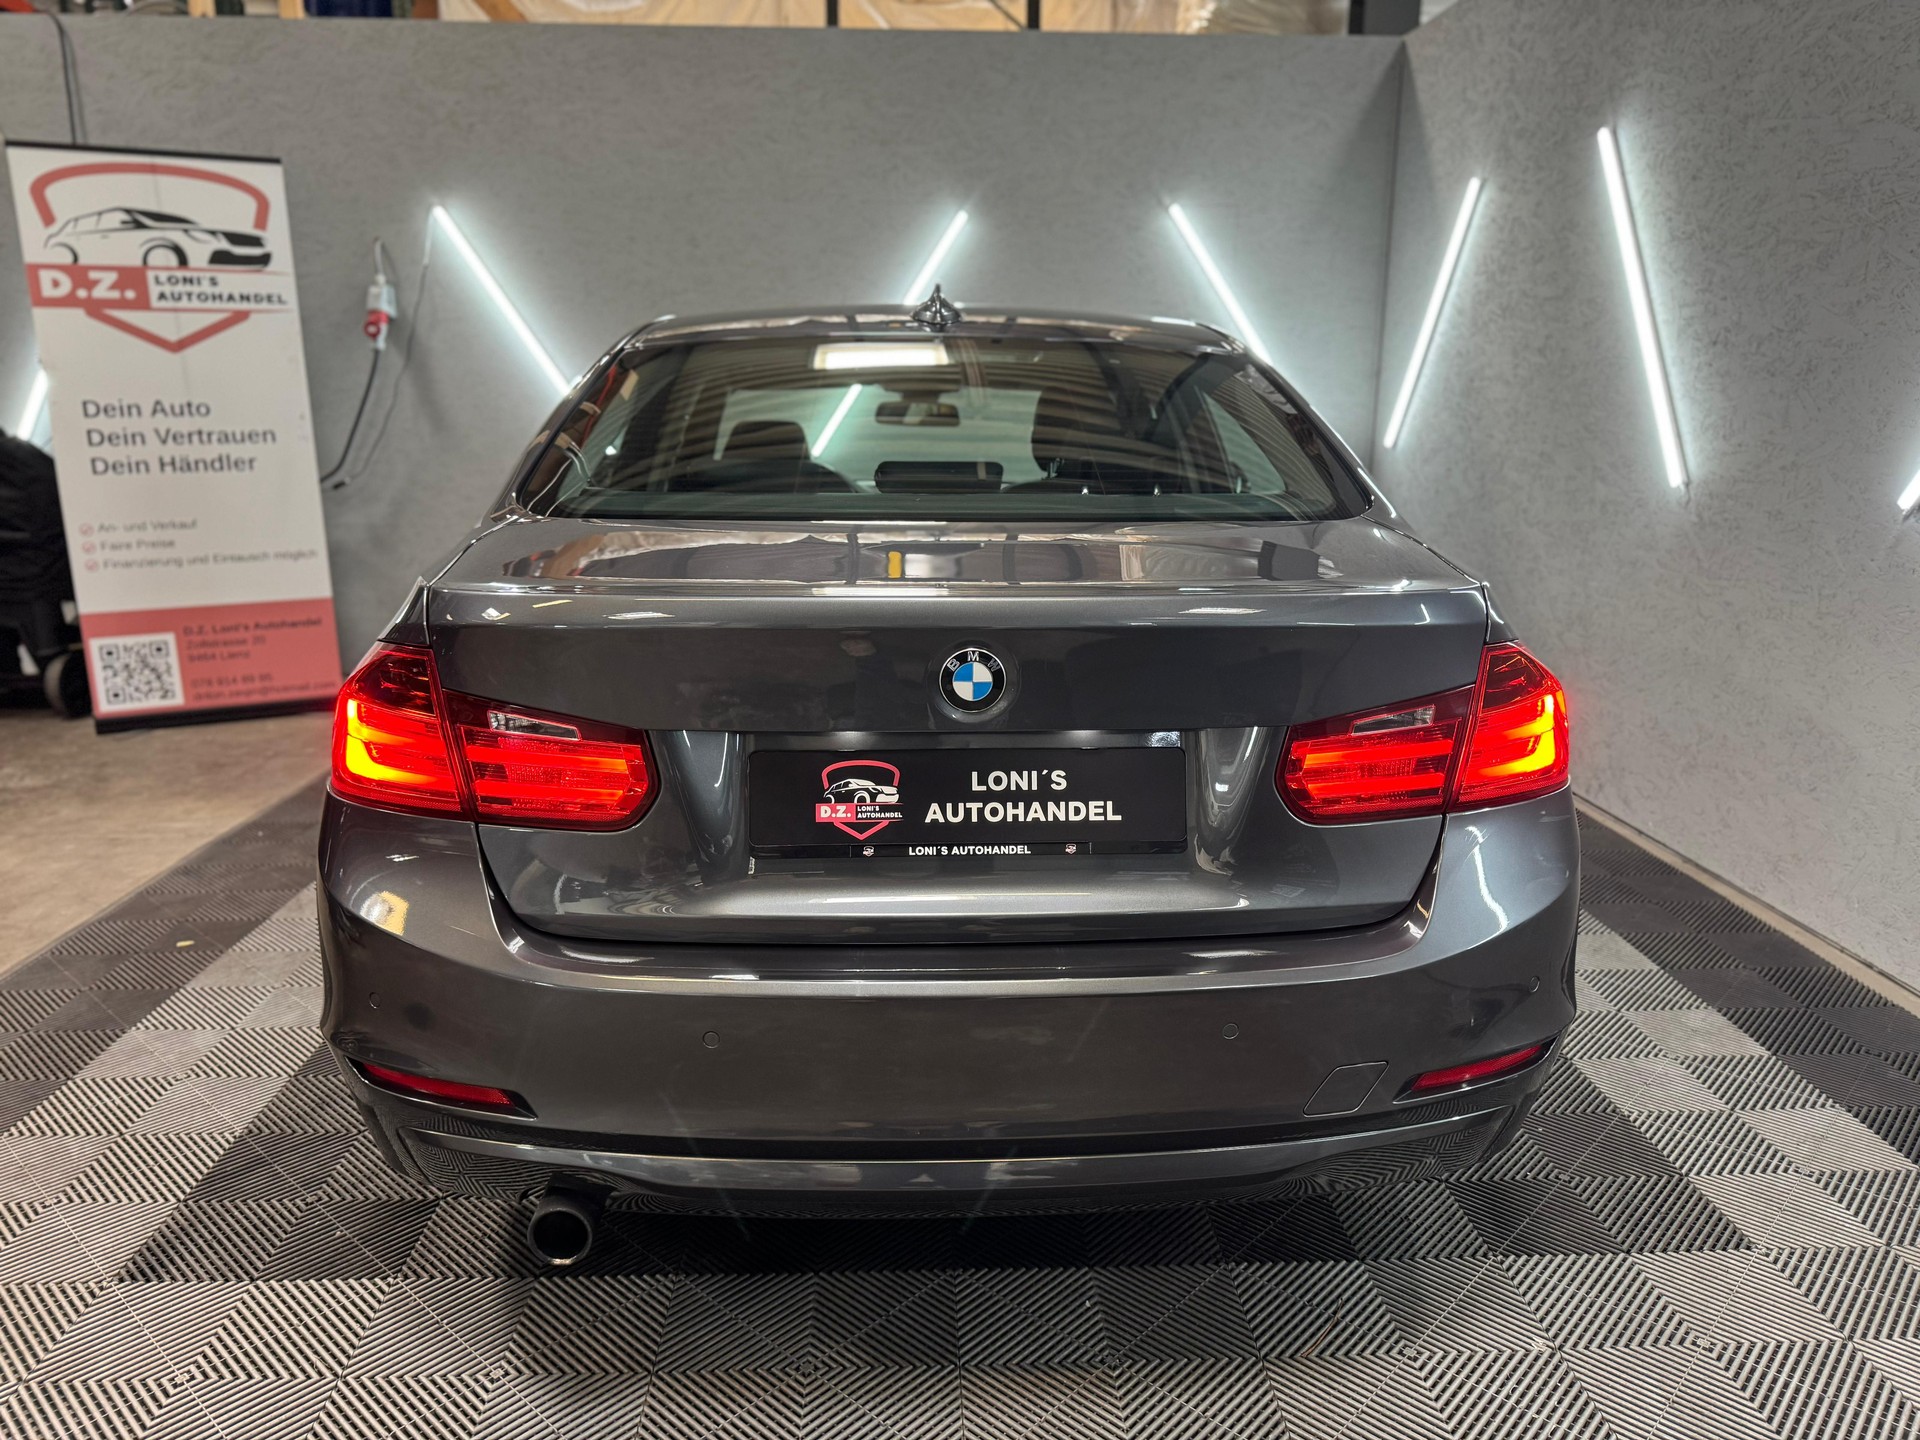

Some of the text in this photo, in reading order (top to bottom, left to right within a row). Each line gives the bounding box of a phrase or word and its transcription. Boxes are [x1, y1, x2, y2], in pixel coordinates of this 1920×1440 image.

[37, 269, 137, 300] D.Z.
[154, 275, 219, 287] LONI'S
[157, 292, 288, 305] AUTOHANDEL
[82, 400, 211, 419] Dein Auto
[86, 427, 277, 447] Dein Vertrauen
[90, 454, 257, 476] Dein Händler
[123, 521, 147, 532] und
[150, 519, 198, 532] Verkauf
[100, 538, 175, 551] Faire Preise
[103, 556, 184, 571] Finanzierung
[187, 554, 210, 566] und
[254, 618, 323, 631] Autohandel
[946, 650, 1001, 672] BMW
[820, 805, 852, 818] D.Z.
[924, 801, 1122, 823] AUTOHANDEL
[951, 845, 1031, 855] AUTOHANDEL
